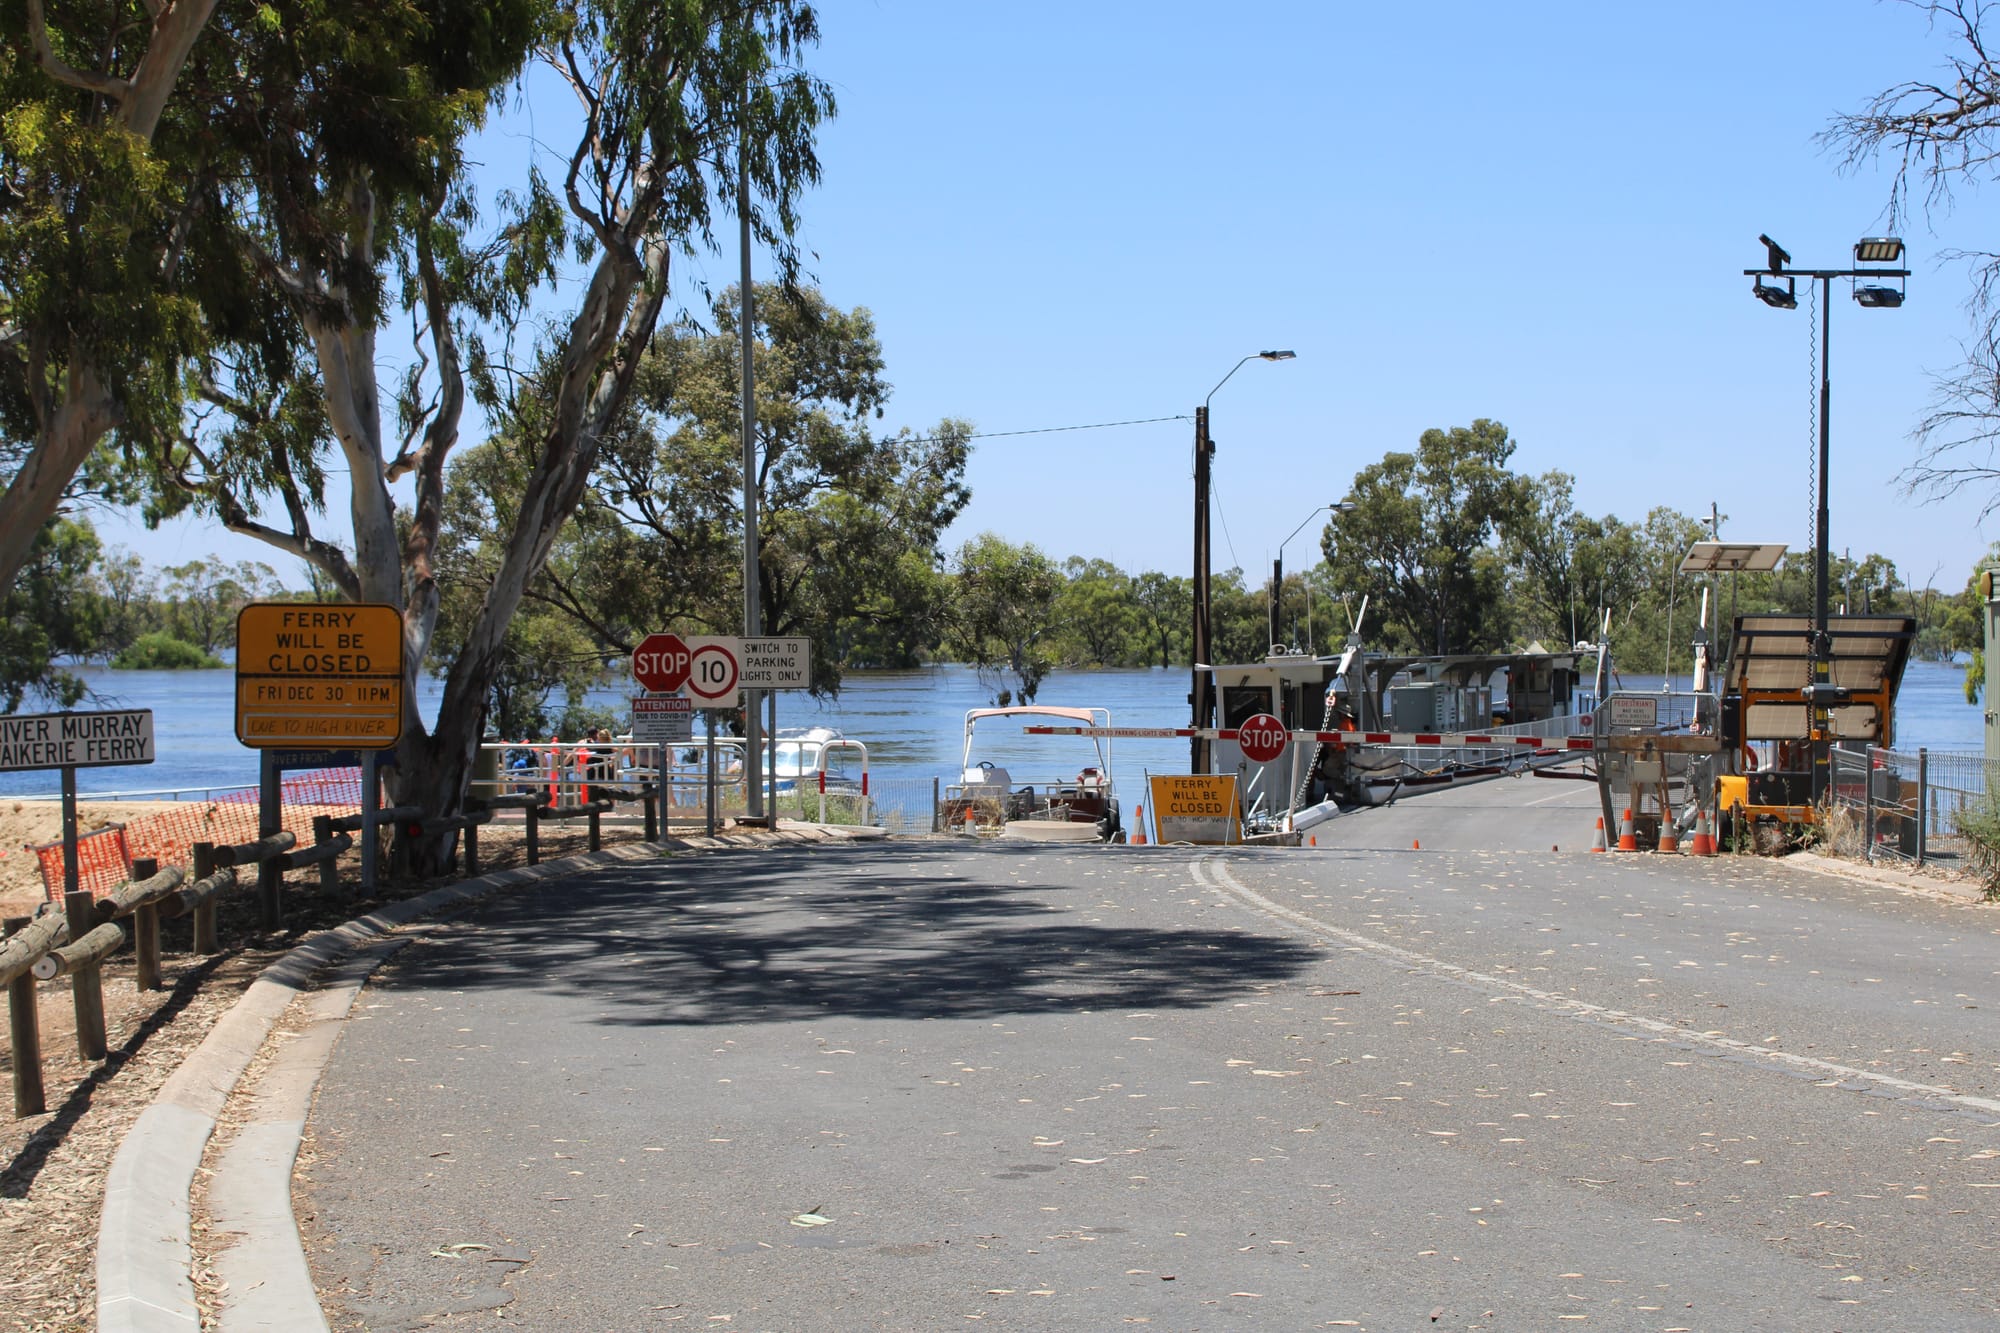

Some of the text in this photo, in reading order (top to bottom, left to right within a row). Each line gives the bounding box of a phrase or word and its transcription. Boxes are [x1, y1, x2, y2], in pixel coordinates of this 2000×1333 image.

[283, 612, 356, 628] FERRY
[276, 634, 364, 649] WILL BE
[744, 642, 798, 654] SWITCH TO
[268, 654, 371, 673] CLOSED
[636, 652, 688, 675] STOP
[746, 657, 795, 668] PARKING
[700, 660, 725, 683] 10
[739, 671, 802, 681] LIGHTS ONLY
[257, 686, 282, 700] FRI
[288, 686, 314, 700] DEC
[325, 686, 344, 701] 30
[634, 700, 689, 710] ATTENTION
[0, 714, 144, 743] IVER MURRAY
[283, 720, 301, 733] TO
[305, 720, 339, 734] HIGH
[344, 720, 386, 734] RIVER
[1241, 730, 1283, 748] STOP
[0, 737, 147, 766] AIKERIE FERRY
[1174, 779, 1212, 788] FERRY
[1172, 791, 1218, 800] WILL BE
[1170, 803, 1223, 813] CLOSED
